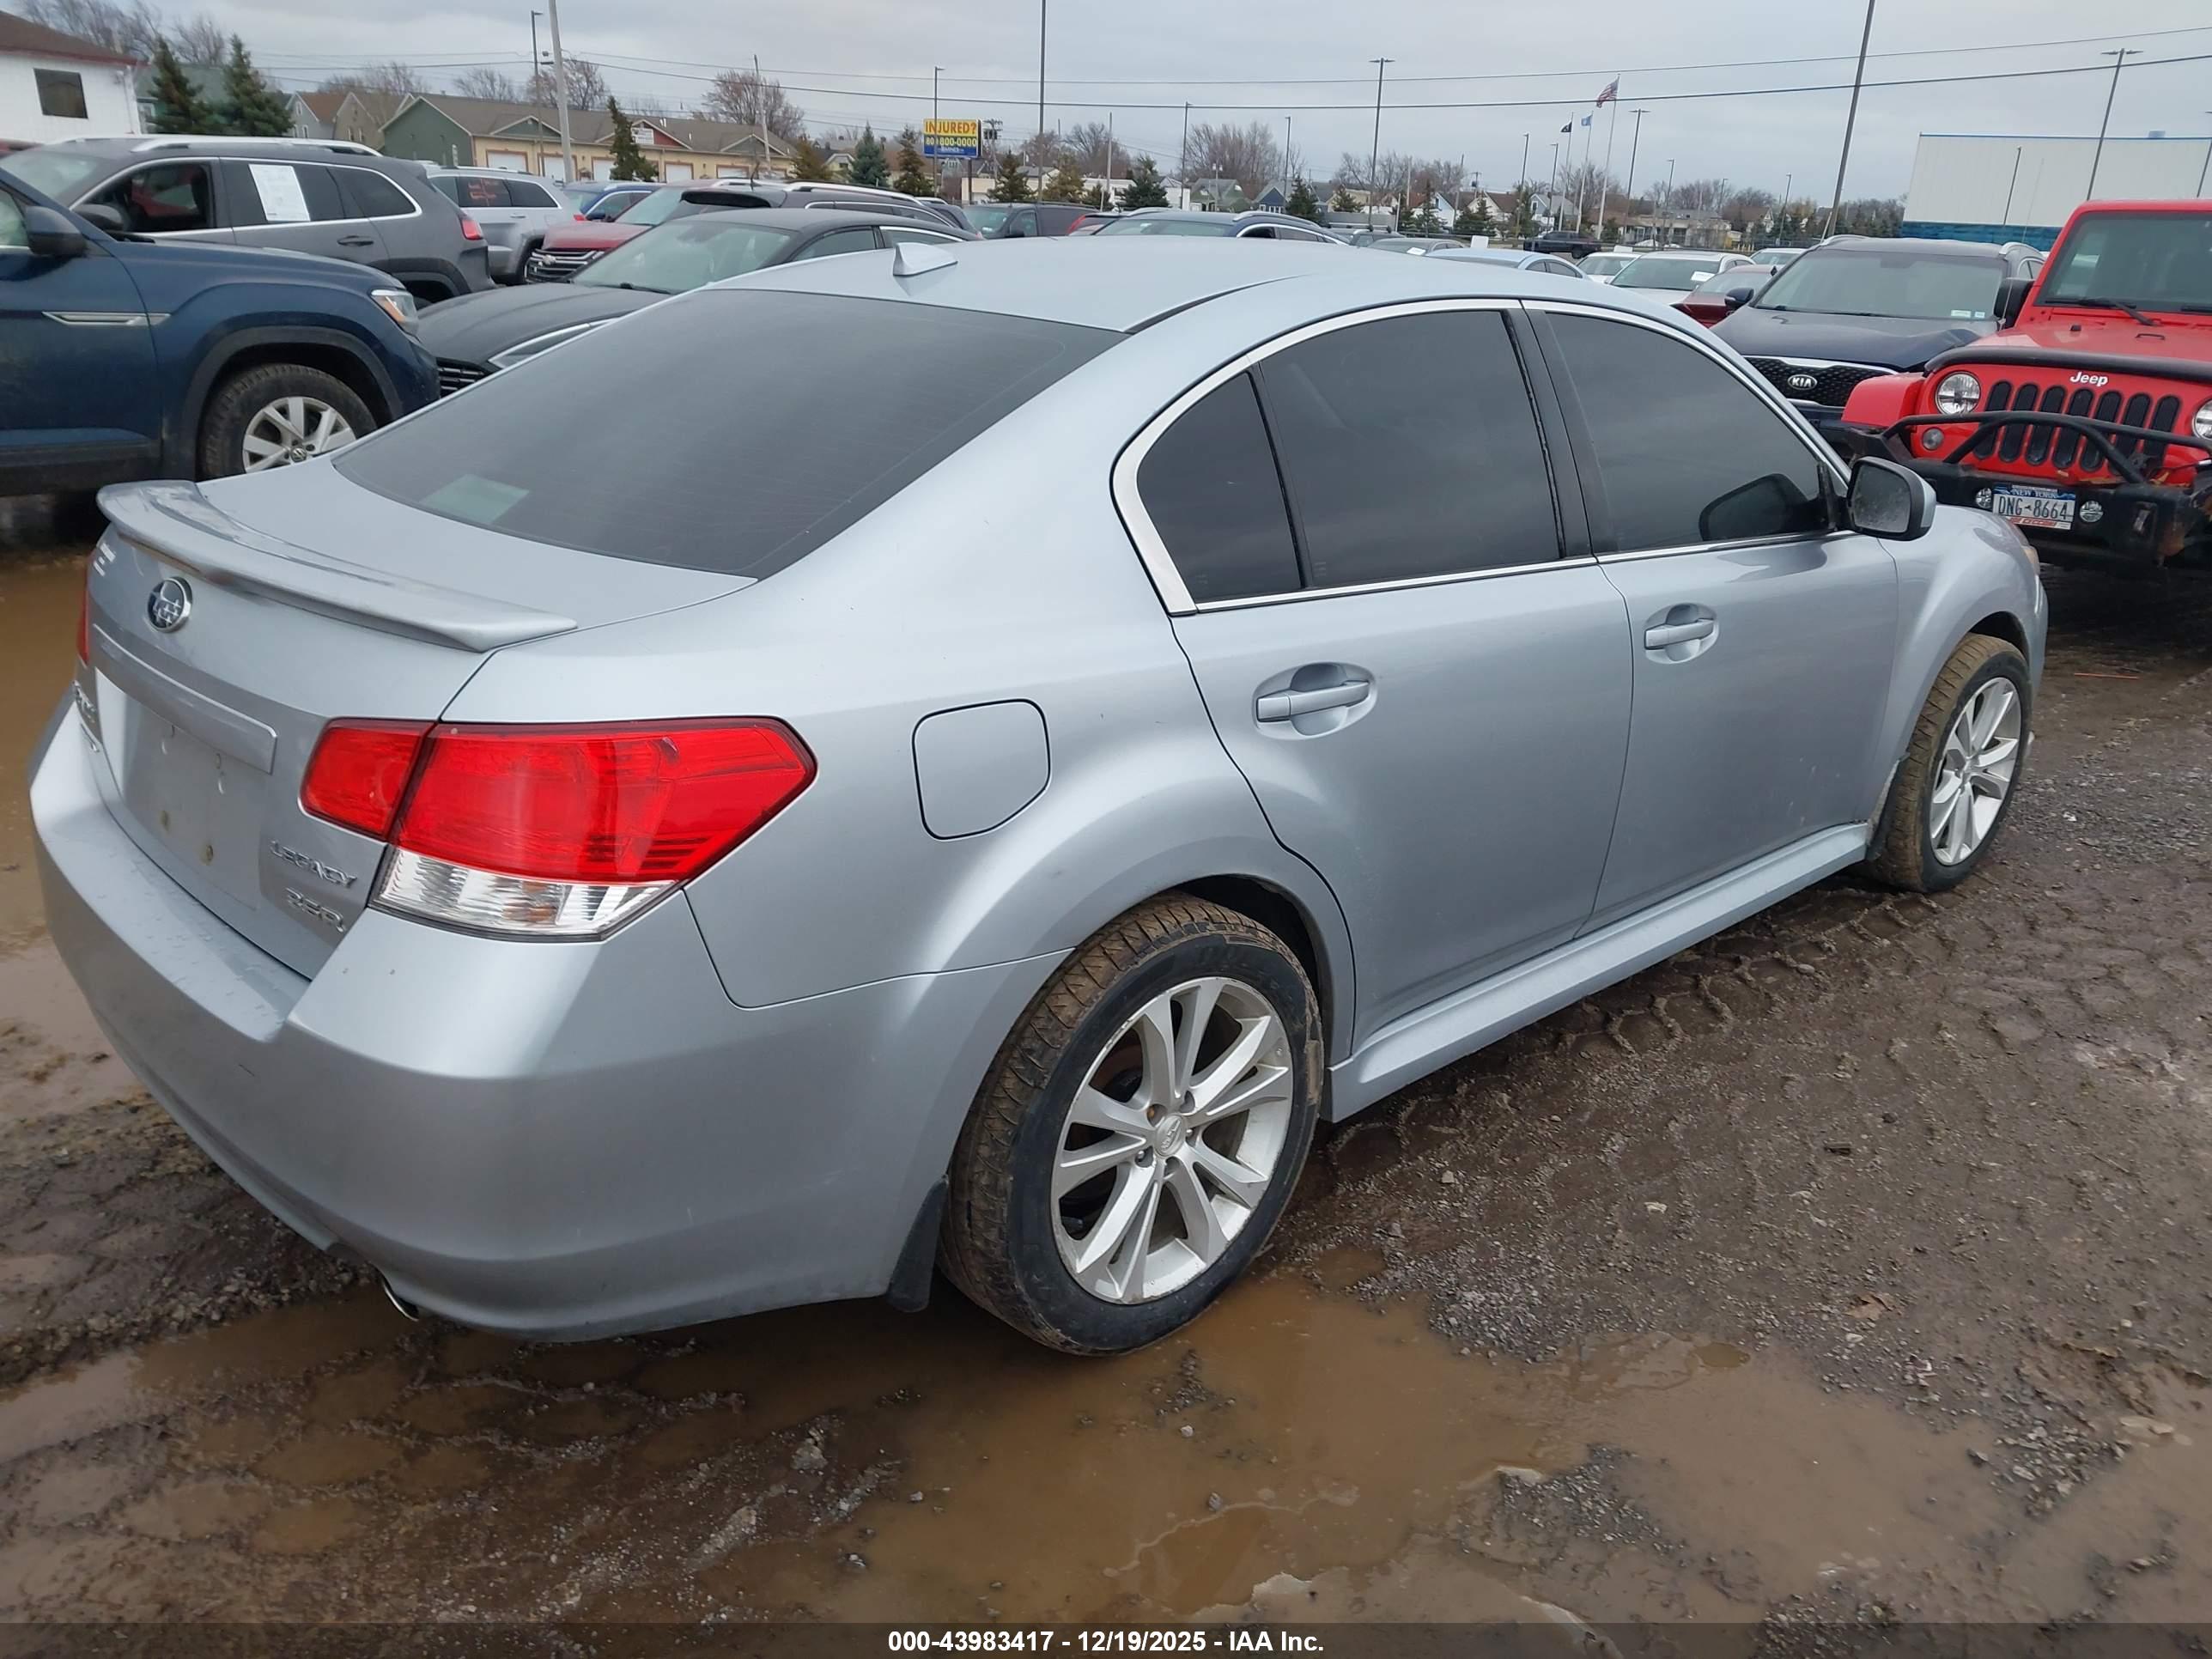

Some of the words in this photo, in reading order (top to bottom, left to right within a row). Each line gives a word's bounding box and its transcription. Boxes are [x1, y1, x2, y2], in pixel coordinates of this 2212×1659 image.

[926, 121, 977, 134] INJURED?
[1792, 377, 1812, 388] KIA
[2069, 371, 2109, 387] Jeep
[1998, 495, 2023, 516] DNG
[2033, 499, 2069, 520] 8664
